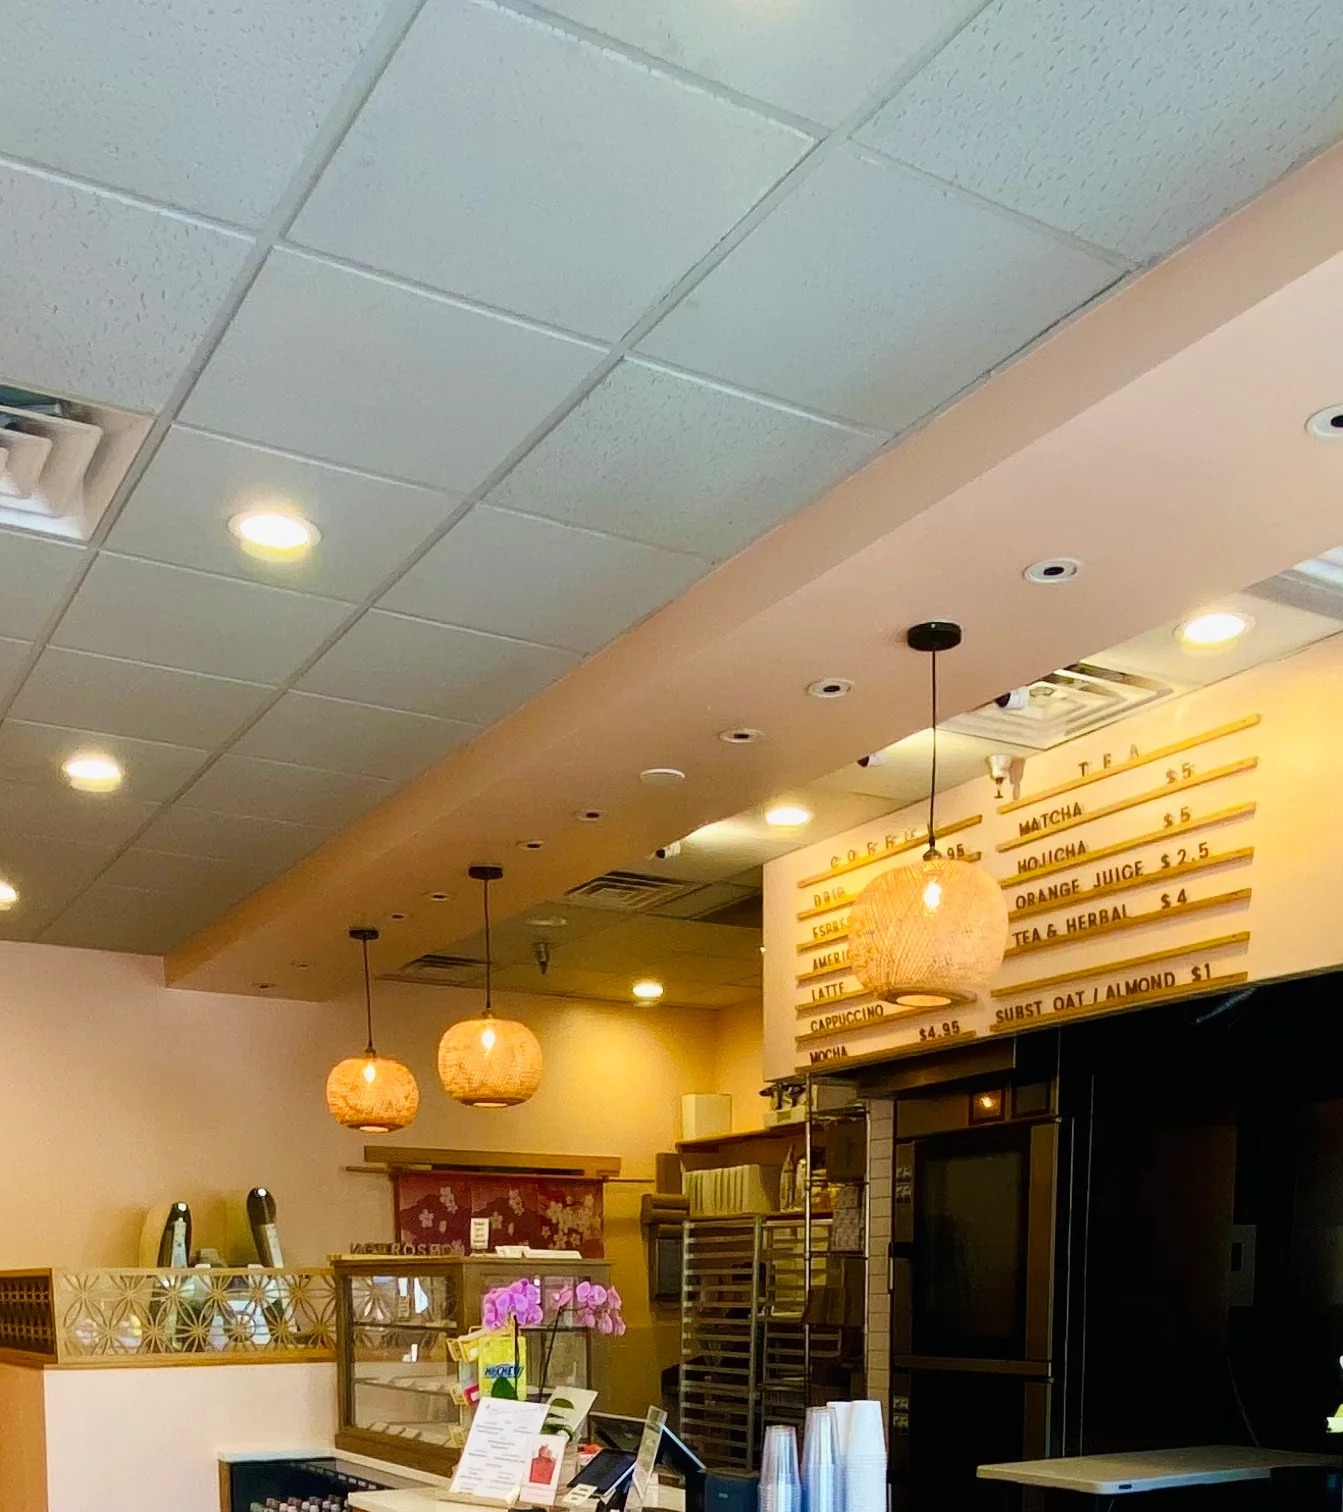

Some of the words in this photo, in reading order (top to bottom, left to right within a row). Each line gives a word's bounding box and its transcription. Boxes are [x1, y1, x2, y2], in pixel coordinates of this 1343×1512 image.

[1079, 743, 1140, 777] TEA
[1017, 840, 1087, 874] HOJICHA
[1163, 806, 1191, 829] $5
[1018, 802, 1083, 837] MATCHA
[1015, 879, 1080, 910] ORANGE
[1093, 860, 1144, 889] JUICE
[1012, 927, 1042, 947] TEA
[1046, 923, 1057, 939] &
[1066, 903, 1129, 933] HERBAL
[1160, 888, 1188, 910] $4
[811, 981, 844, 1002] LATTE
[995, 1000, 1043, 1024] SUBST
[1053, 990, 1085, 1010] OAT
[1106, 971, 1176, 1000] ALMOND
[1191, 963, 1212, 983] $1
[810, 1004, 884, 1033] CAPPUCCINO
[809, 1045, 848, 1064] MOCHA
[918, 1020, 960, 1042] $4.95
